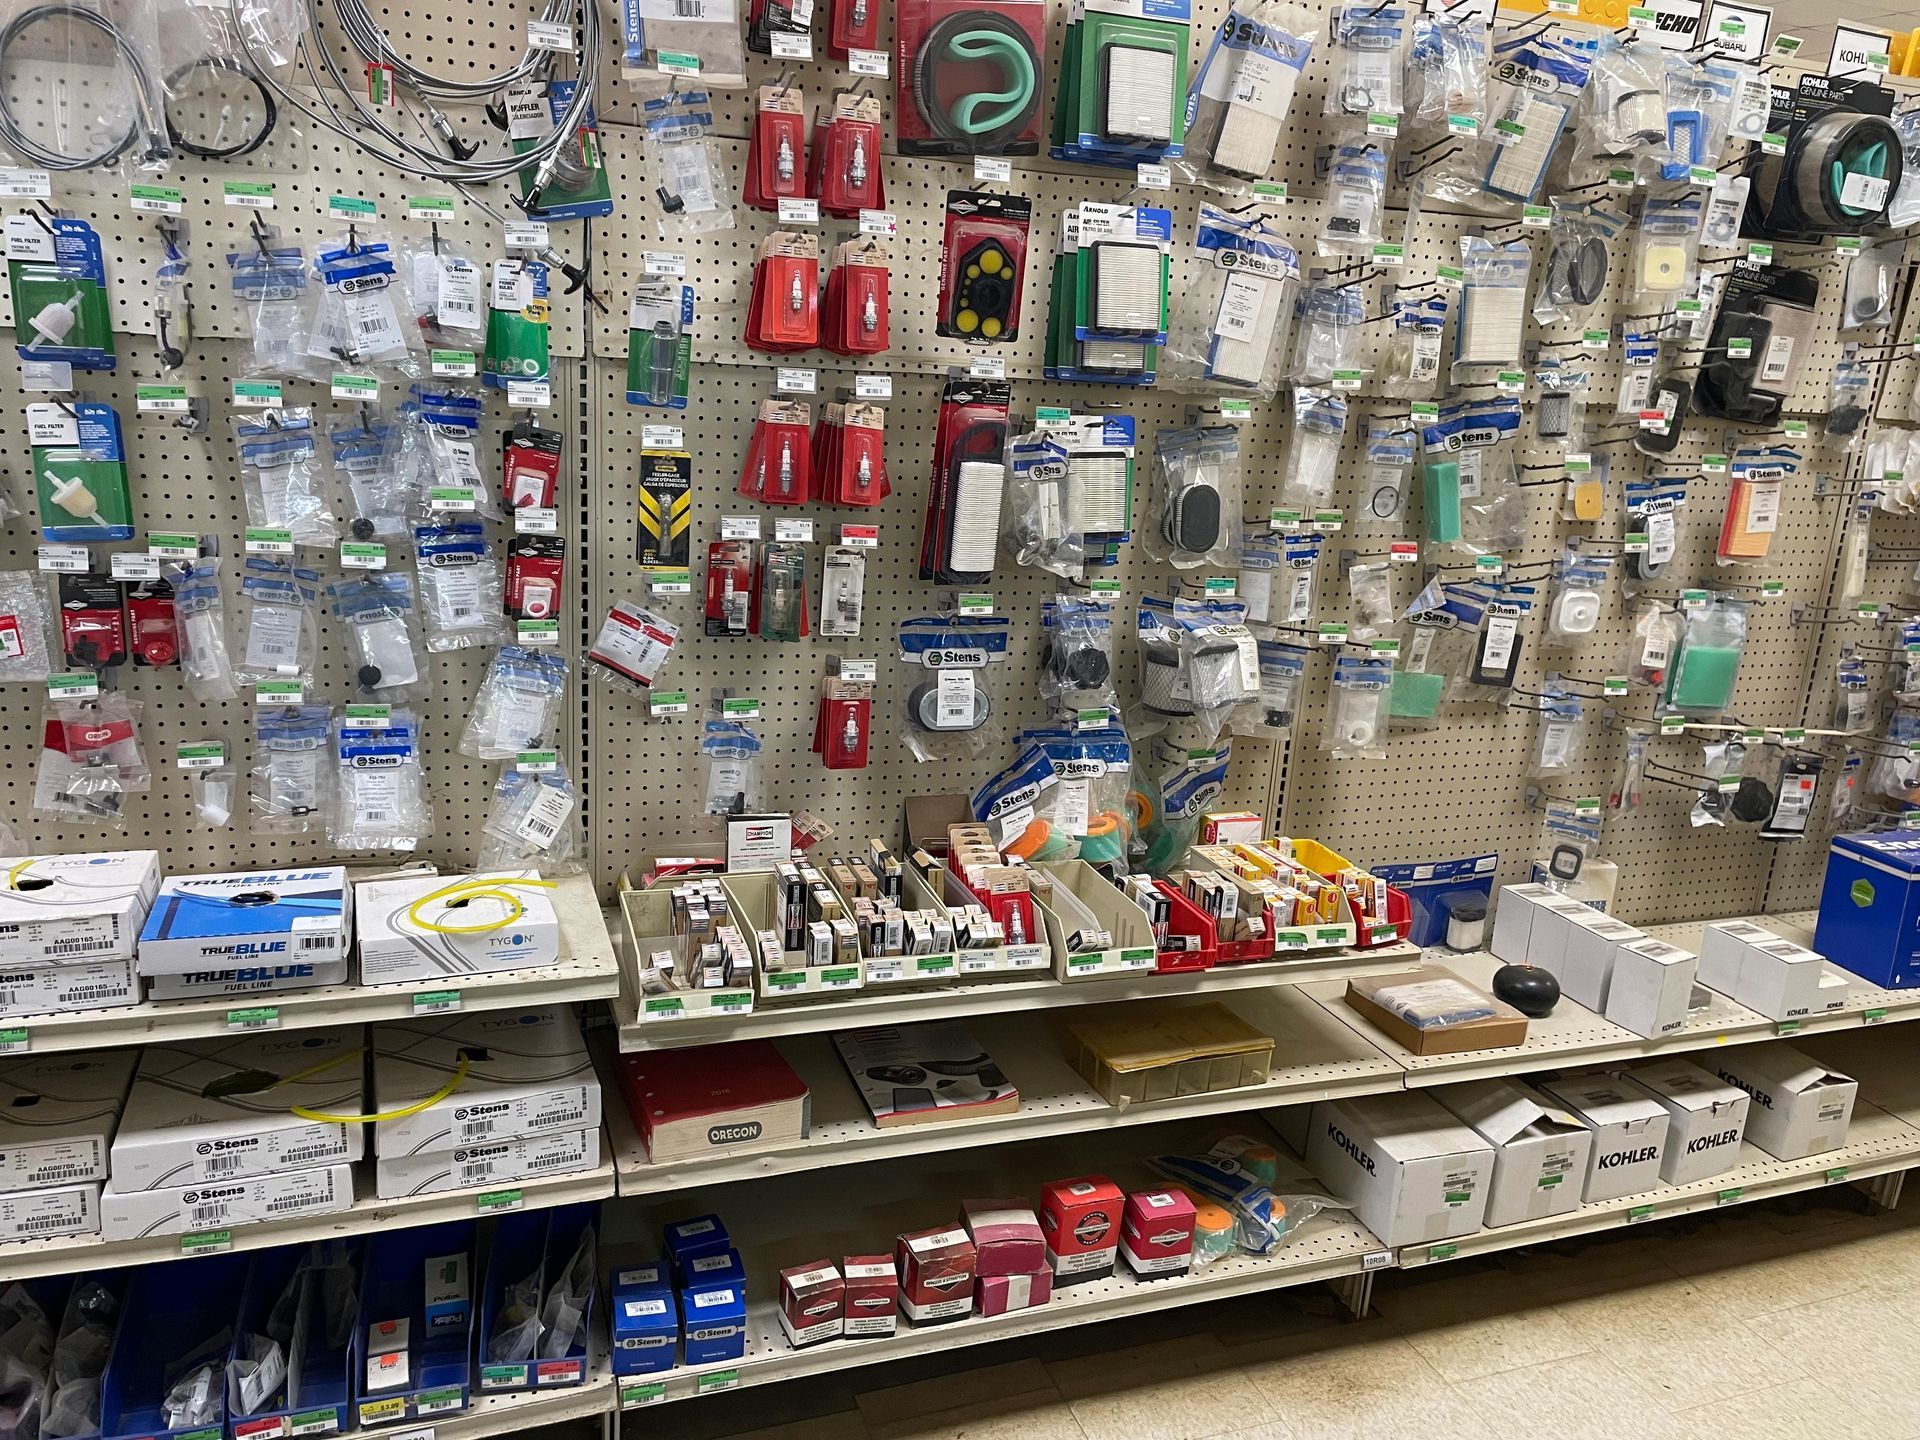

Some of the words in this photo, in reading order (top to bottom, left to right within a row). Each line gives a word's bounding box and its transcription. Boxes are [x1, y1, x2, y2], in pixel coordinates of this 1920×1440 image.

[627, 0, 638, 43] Stens
[1655, 12, 1699, 34] ECHO
[1714, 40, 1746, 52] SUBARU
[1839, 49, 1868, 63] KOHL
[1515, 68, 1551, 87] Stens
[1802, 76, 1829, 89] KOHLER
[1770, 89, 1791, 99] OHLER
[1801, 86, 1828, 97] GENUINE
[1829, 92, 1845, 101] PARTS
[1771, 97, 1788, 106] NUINE
[1239, 253, 1279, 273] Stens
[1736, 258, 1761, 272] KOHLER
[355, 277, 383, 290] Stens
[531, 304, 544, 312] riety
[446, 426, 466, 436] Stens
[1461, 430, 1493, 443] tens
[505, 470, 513, 490] GENUINE
[1757, 470, 1782, 478] Stens
[446, 554, 474, 562] Stens
[944, 652, 981, 663] Stens
[368, 757, 397, 765] Stens
[1068, 763, 1099, 773] Stens
[1001, 788, 1036, 809] Stens
[1195, 786, 1215, 805] Stens
[180, 871, 332, 888] TRUEBLUE
[489, 934, 532, 946] TYGON
[200, 941, 286, 955] TRUEBLUE
[0, 973, 34, 983] tens
[182, 964, 313, 983] TRUEBLUE
[224, 983, 249, 991] FUEL
[251, 981, 273, 990] LINE
[1787, 1008, 1808, 1016] KOHLER
[1662, 1021, 1681, 1032] KOHLER
[1718, 1068, 1773, 1110] KOHLER
[470, 1103, 509, 1117] Stens
[711, 1125, 758, 1141] OREGON
[214, 1137, 259, 1151] Stens
[1687, 1129, 1739, 1154] KOHLER
[469, 1145, 509, 1158] Stens
[1328, 1122, 1375, 1177] KOHLER
[1599, 1147, 1657, 1169] KOHLER
[200, 1186, 245, 1200] Stens
[1366, 1256, 1386, 1265] 10R08
[434, 1314, 462, 1325] Pollak
[707, 1328, 732, 1337] Stens
[637, 1337, 662, 1347] Stens
